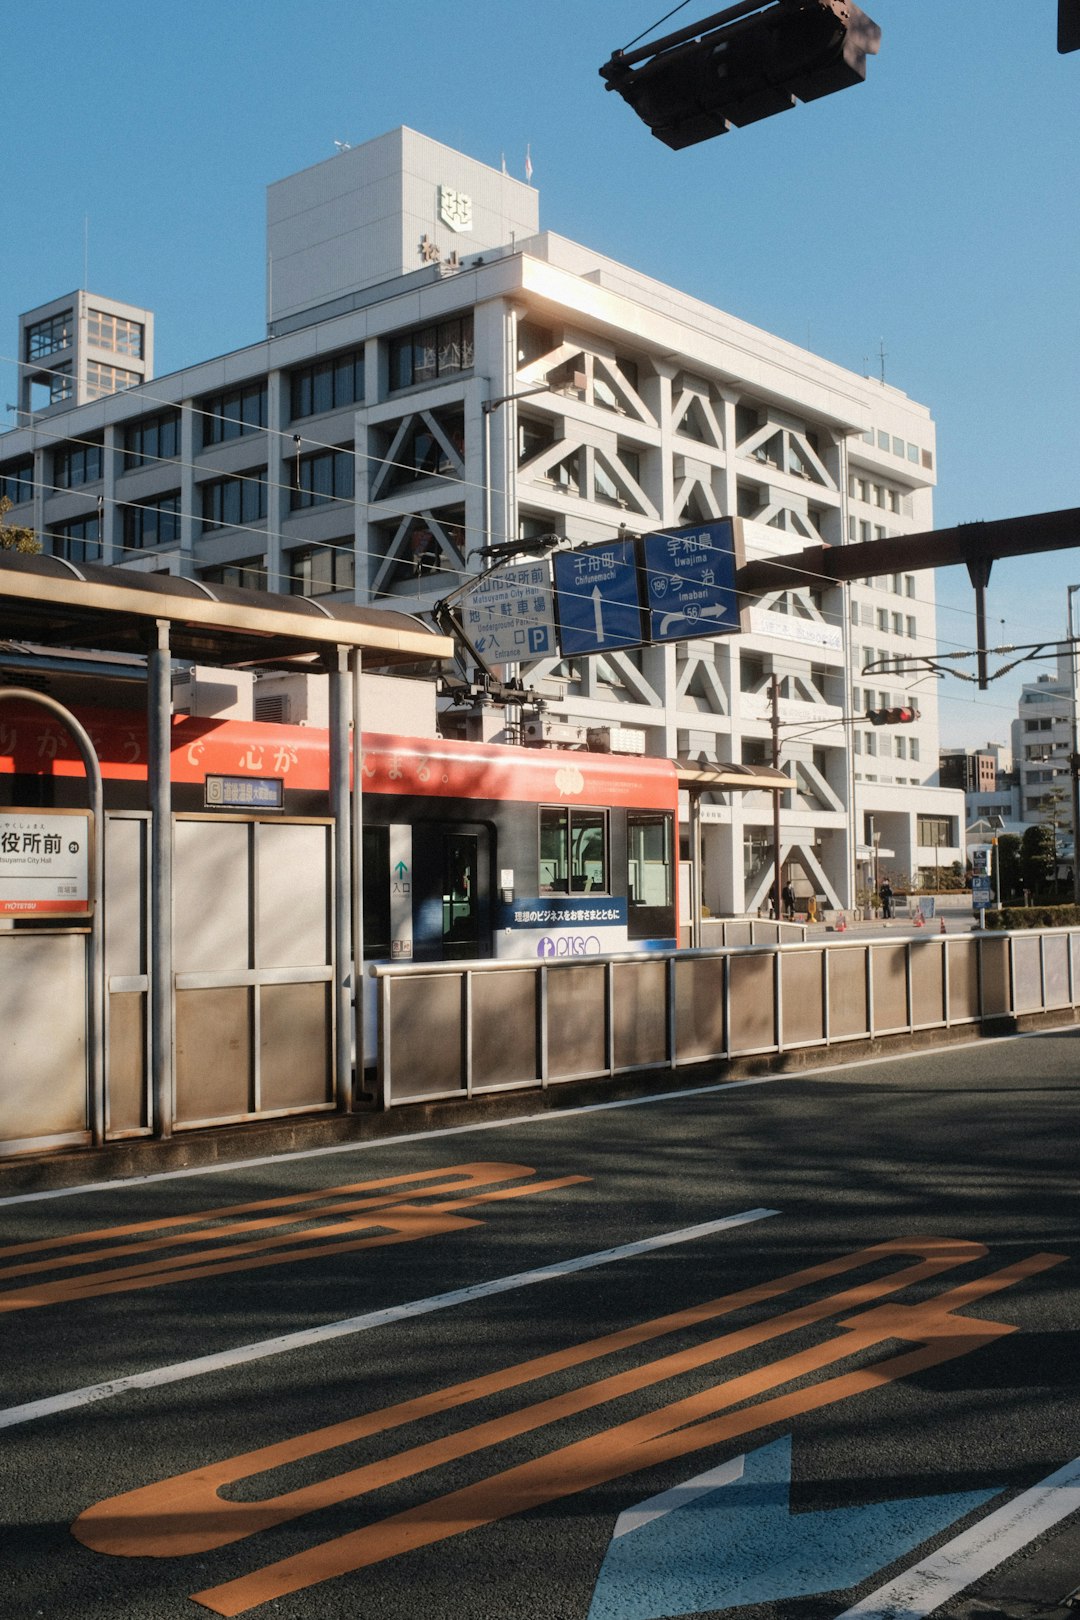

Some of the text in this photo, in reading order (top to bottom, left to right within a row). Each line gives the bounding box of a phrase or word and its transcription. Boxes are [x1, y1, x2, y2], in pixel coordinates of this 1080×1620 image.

[667, 533, 713, 556] 宇和島
[574, 552, 614, 574] 千舟町
[674, 554, 707, 567] Uwajima
[575, 570, 617, 585] Chifunemachi
[670, 569, 715, 591] 今治
[653, 580, 666, 591] 196
[473, 586, 539, 604] Matsuyama City Hall
[679, 589, 708, 601] Imabari
[469, 597, 546, 624] 地下駐車場
[686, 606, 698, 617] 56
[478, 618, 515, 632] Underground
[489, 630, 525, 649] 入口
[532, 629, 545, 651] P
[495, 649, 521, 659] Entrance
[1, 832, 62, 854] 役所前
[393, 883, 410, 893] 入口
[515, 909, 620, 922] 理想のビジネスをお客さまとともに
